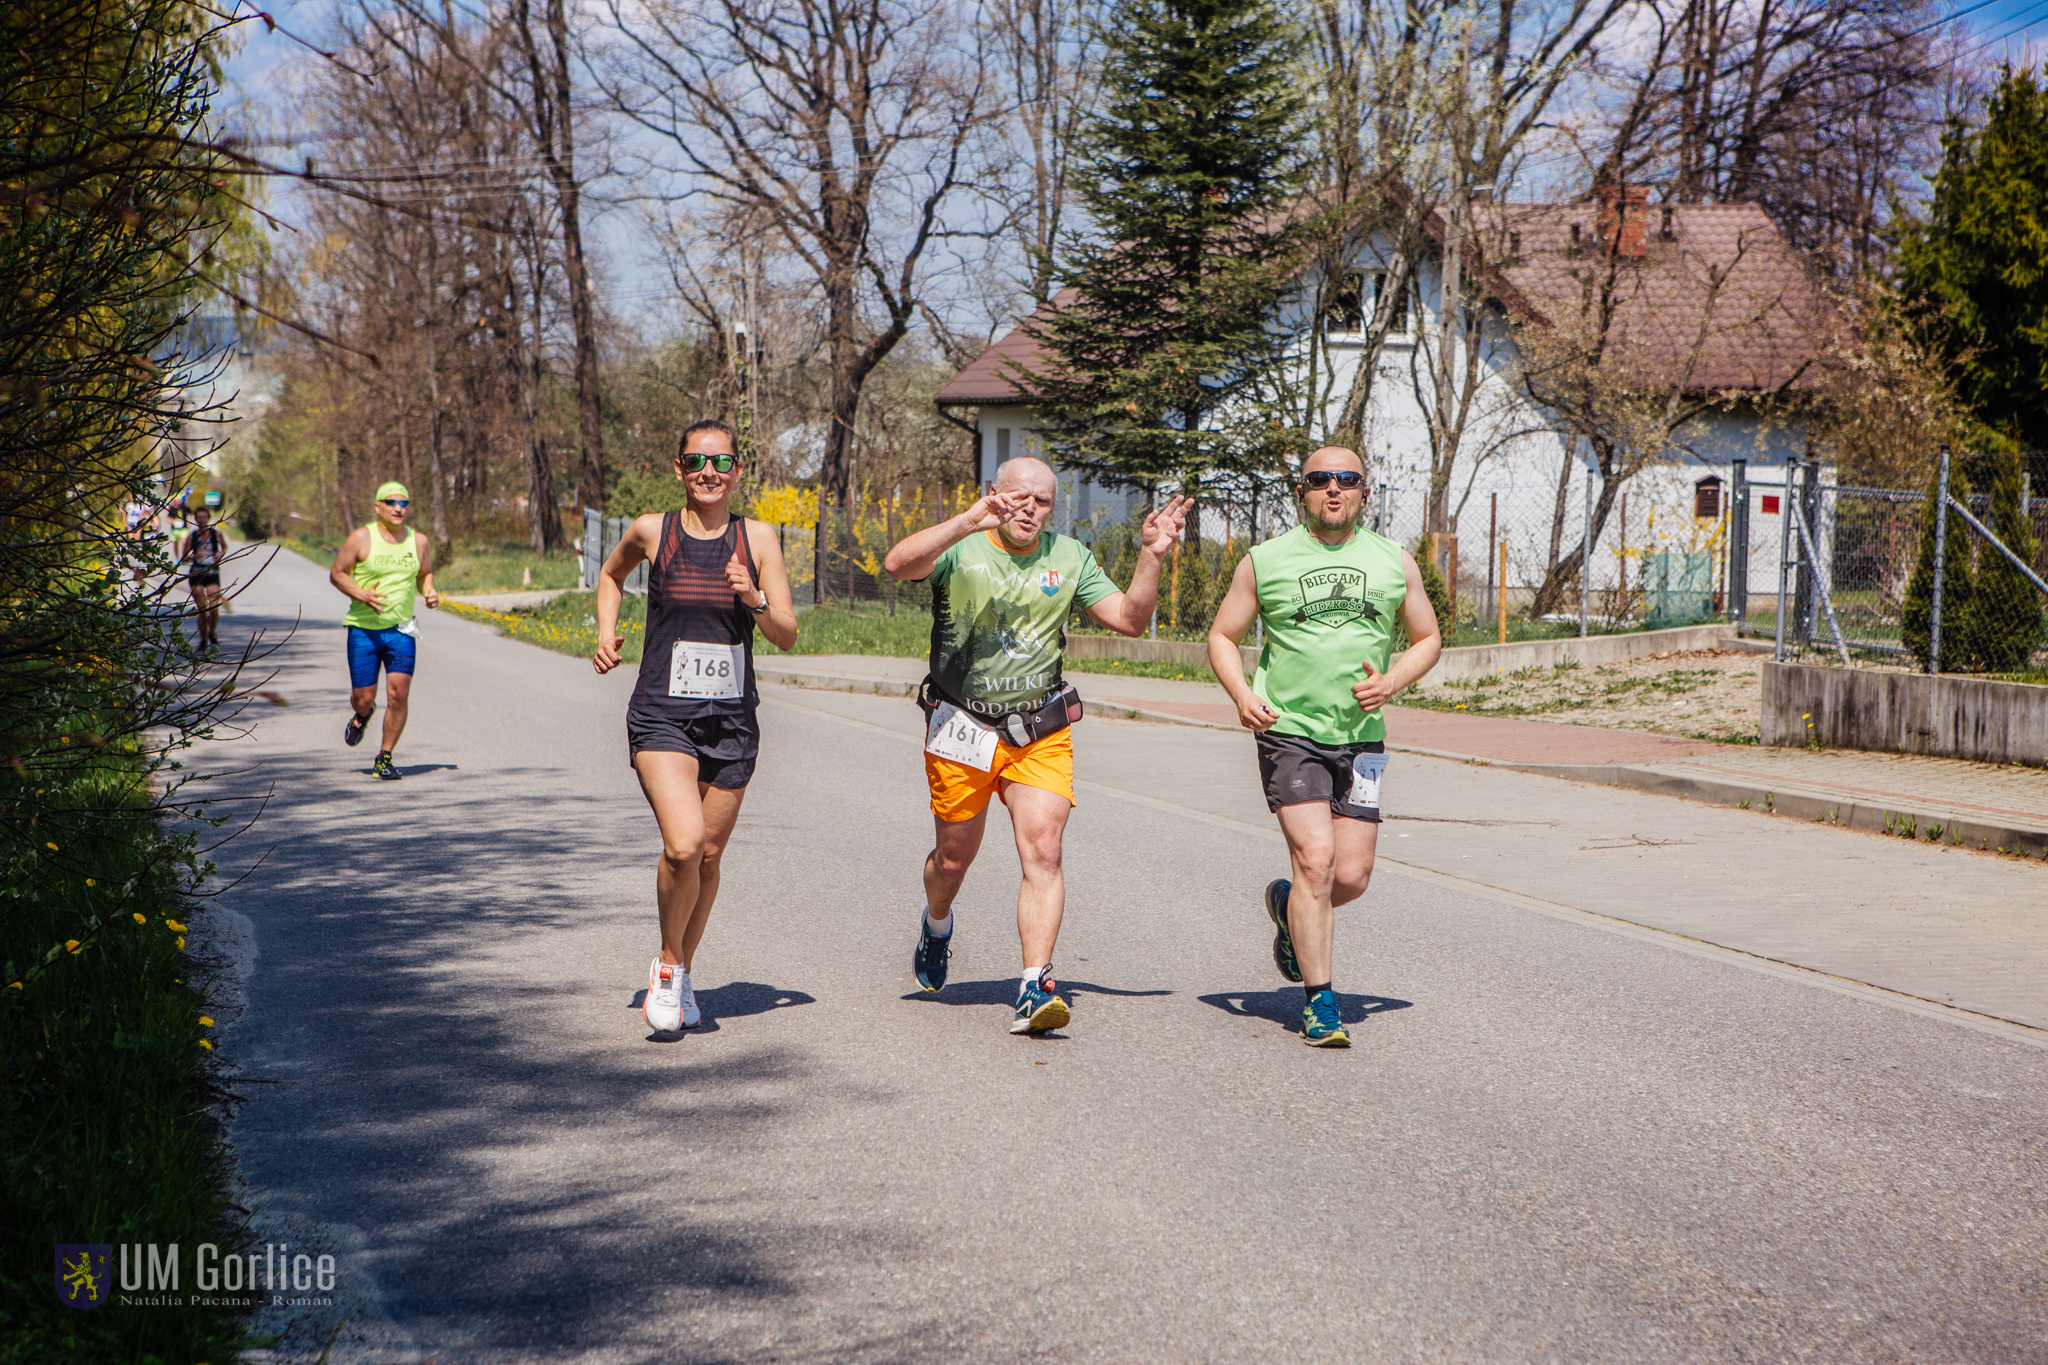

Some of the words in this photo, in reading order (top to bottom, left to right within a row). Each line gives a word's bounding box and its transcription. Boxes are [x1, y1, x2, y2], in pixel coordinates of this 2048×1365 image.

[1304, 573, 1361, 589] BIEGAM
[1291, 595, 1302, 603] BO
[1367, 590, 1385, 599] MNIE
[1303, 598, 1365, 616] LUDZKOŚĆ
[694, 658, 730, 678] 168
[983, 674, 1043, 692] WILKI
[949, 721, 977, 745] 161
